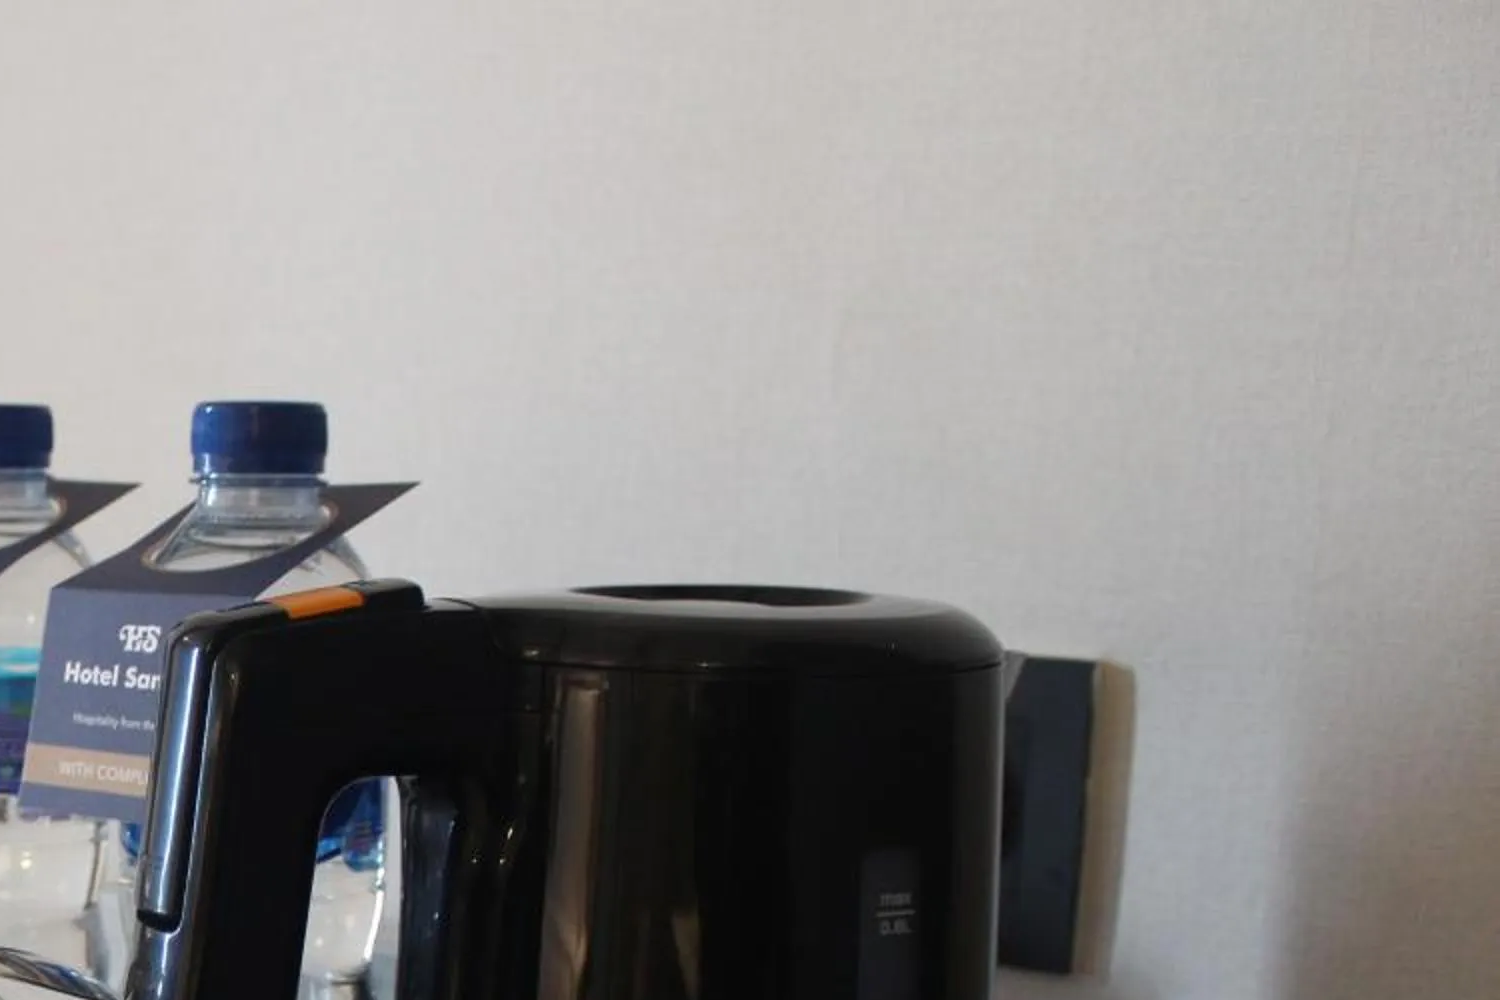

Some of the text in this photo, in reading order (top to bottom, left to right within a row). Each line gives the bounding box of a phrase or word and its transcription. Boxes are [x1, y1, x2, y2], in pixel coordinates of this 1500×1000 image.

[64, 660, 119, 687] Hotel
[121, 715, 141, 730] from
[58, 761, 149, 785] WITH COMPLI
